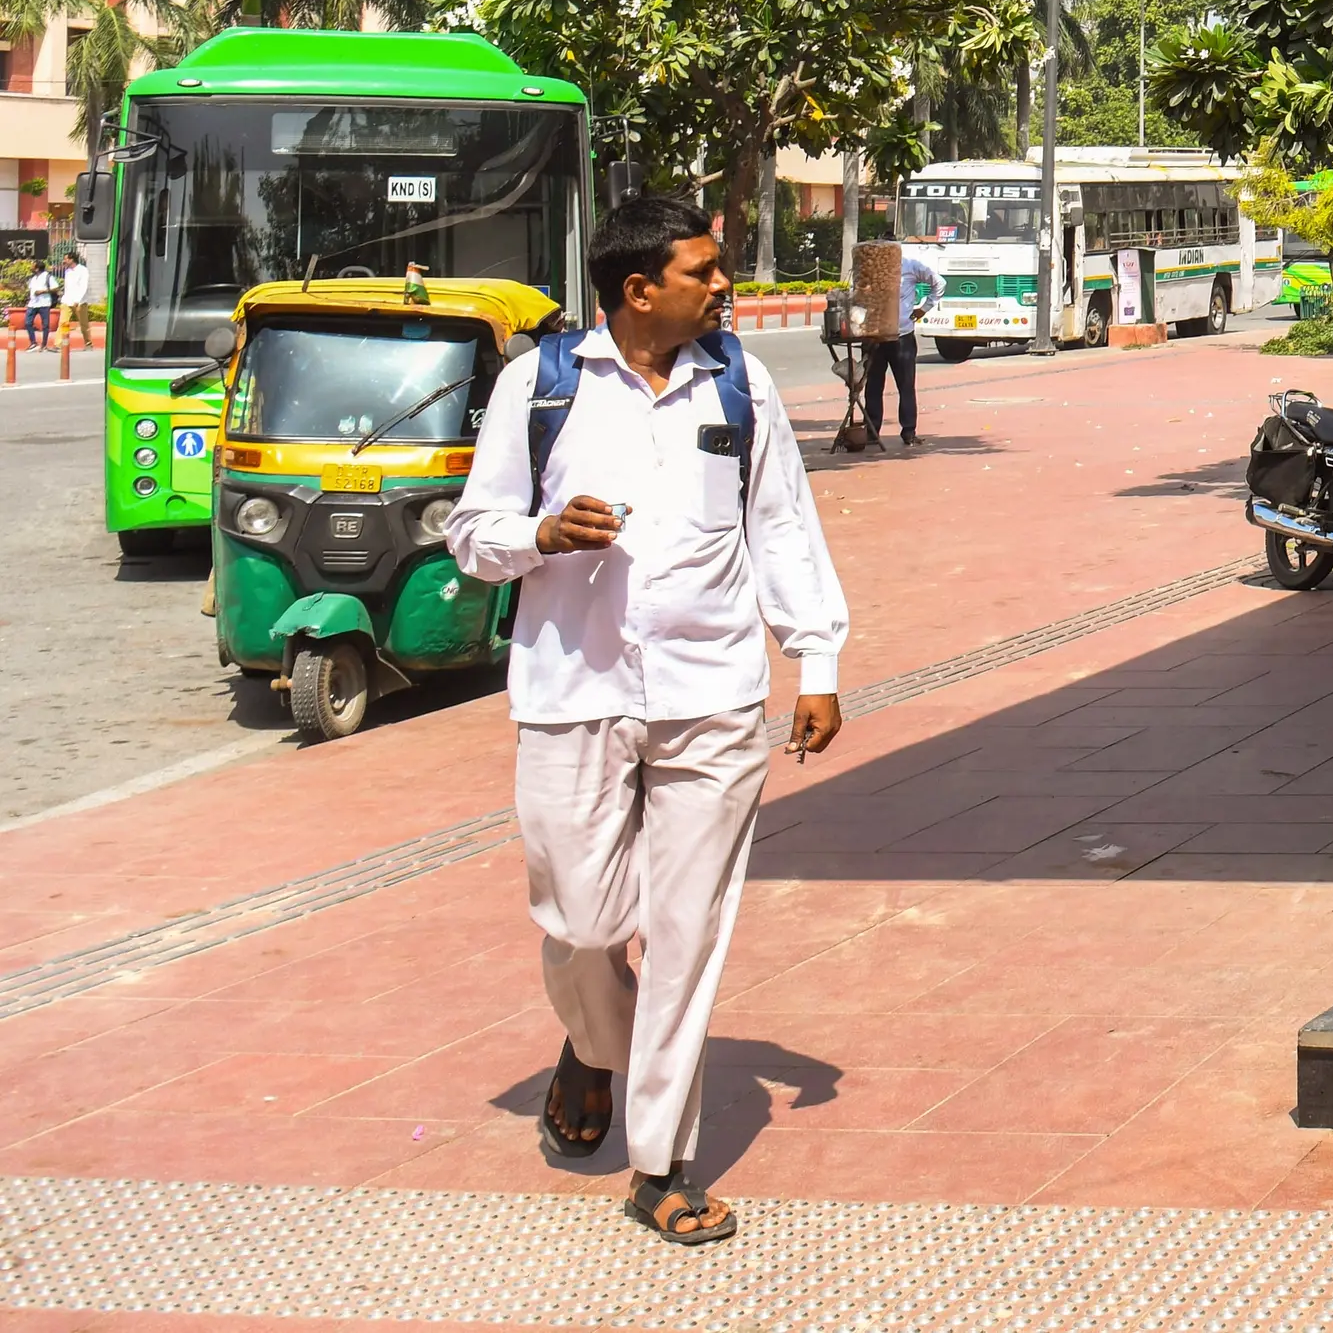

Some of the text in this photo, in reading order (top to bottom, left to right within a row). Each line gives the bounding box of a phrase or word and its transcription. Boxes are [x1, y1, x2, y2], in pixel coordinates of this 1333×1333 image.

[391, 181, 433, 199] KND (S)
[905, 185, 1041, 198] TOURIST
[1178, 248, 1204, 266] INDIAN
[929, 317, 949, 325] SPEED
[336, 519, 358, 532] RE
[440, 585, 459, 596] CNG
